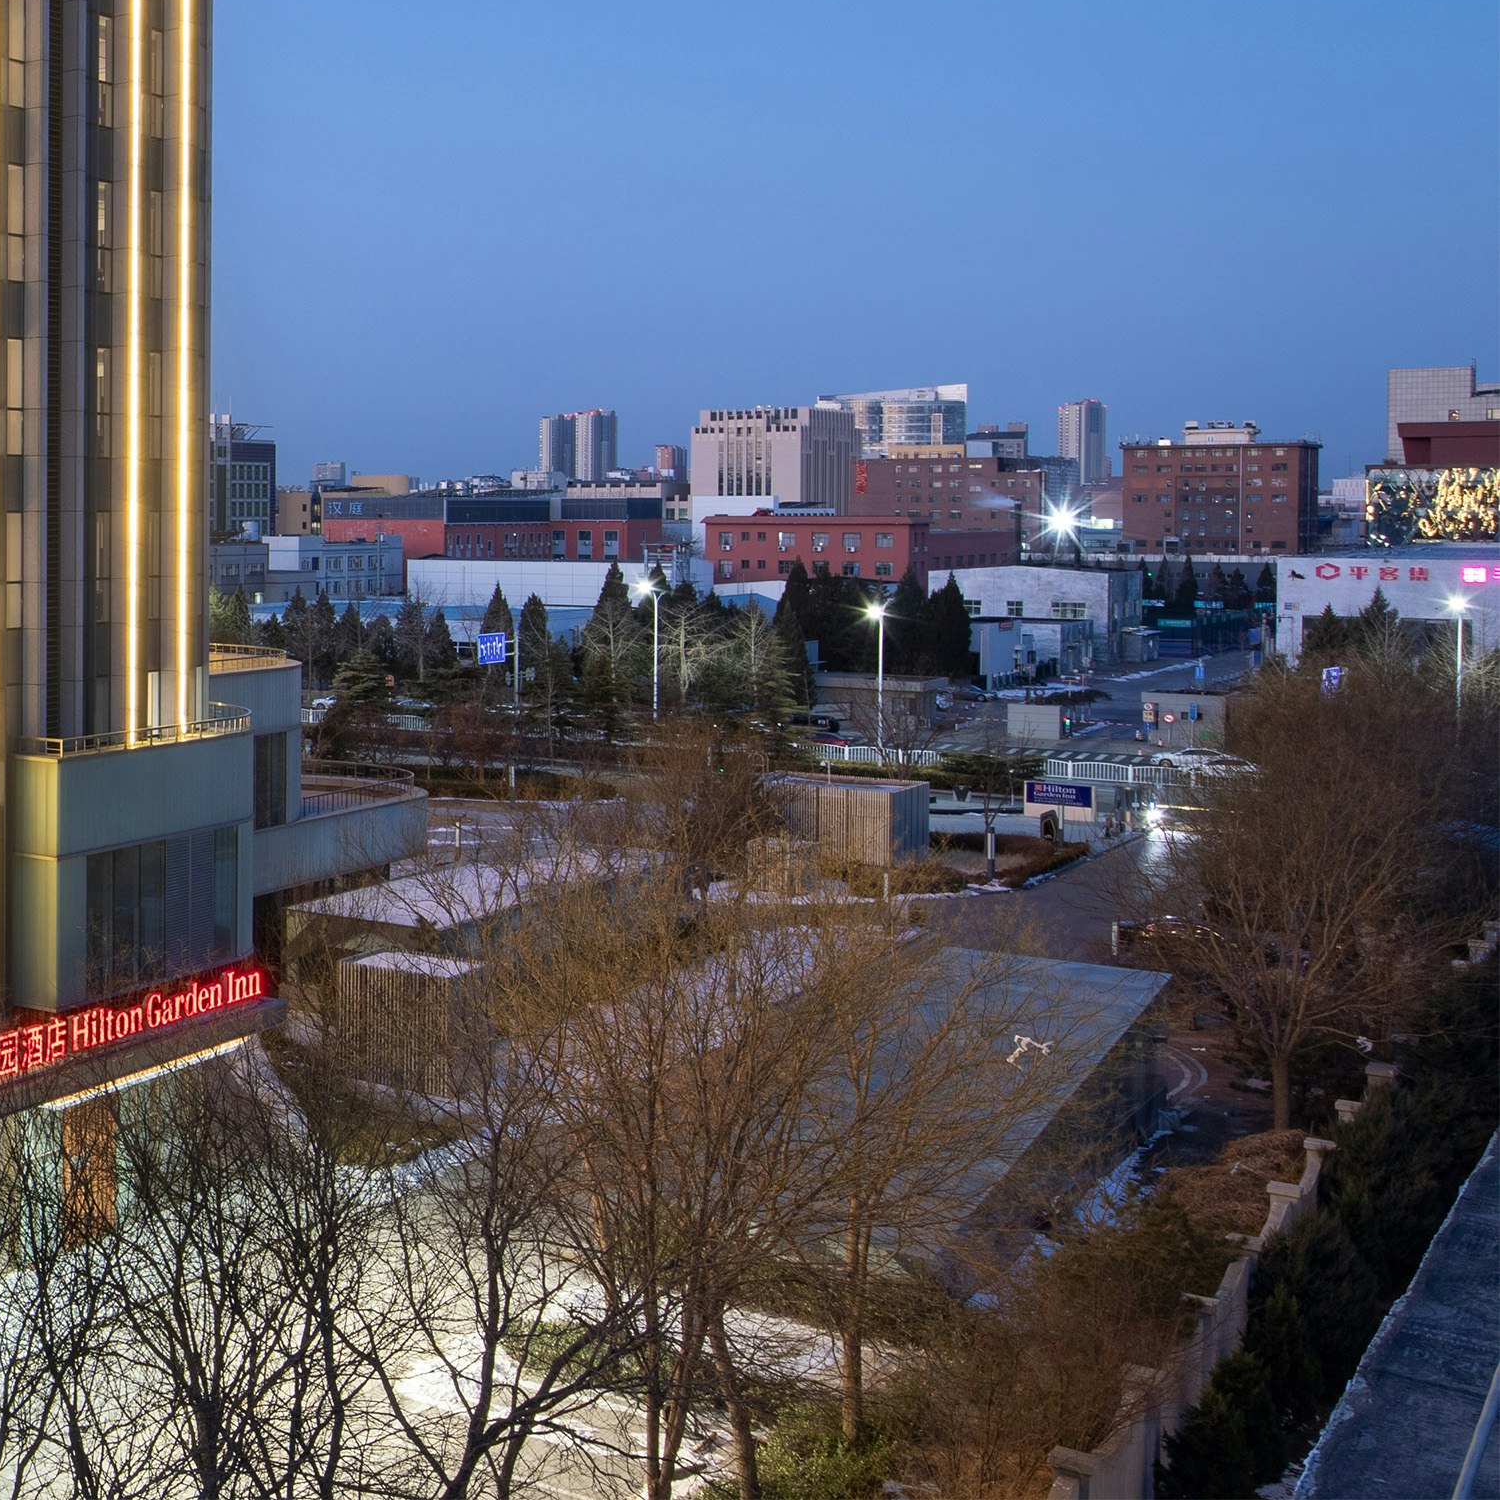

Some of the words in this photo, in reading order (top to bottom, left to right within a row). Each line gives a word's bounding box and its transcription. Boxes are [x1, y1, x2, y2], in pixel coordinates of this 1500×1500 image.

[328, 501, 364, 515] 汉庭
[1043, 784, 1076, 795] Hilton
[72, 1006, 143, 1051] Hilton
[146, 982, 223, 1028] Garden
[226, 970, 262, 1004] Inn
